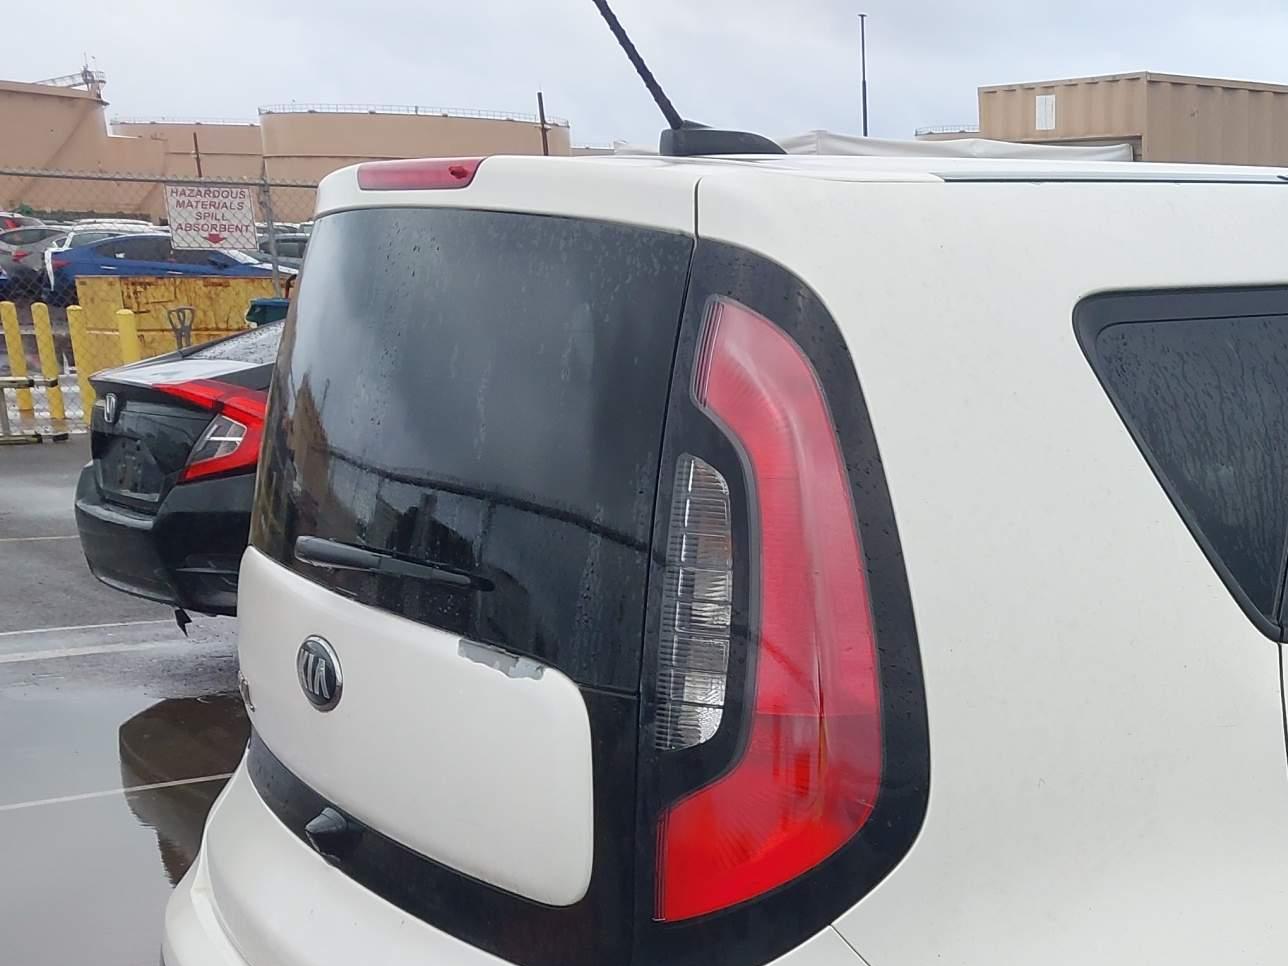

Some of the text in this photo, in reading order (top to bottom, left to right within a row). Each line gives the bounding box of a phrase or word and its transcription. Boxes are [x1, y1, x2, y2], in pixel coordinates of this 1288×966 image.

[170, 188, 246, 199] HAZARDOUS
[175, 200, 245, 211] MATERIALS
[195, 211, 230, 221] SPILL
[175, 223, 250, 233] ABSORBENT
[301, 648, 330, 700] KIA
